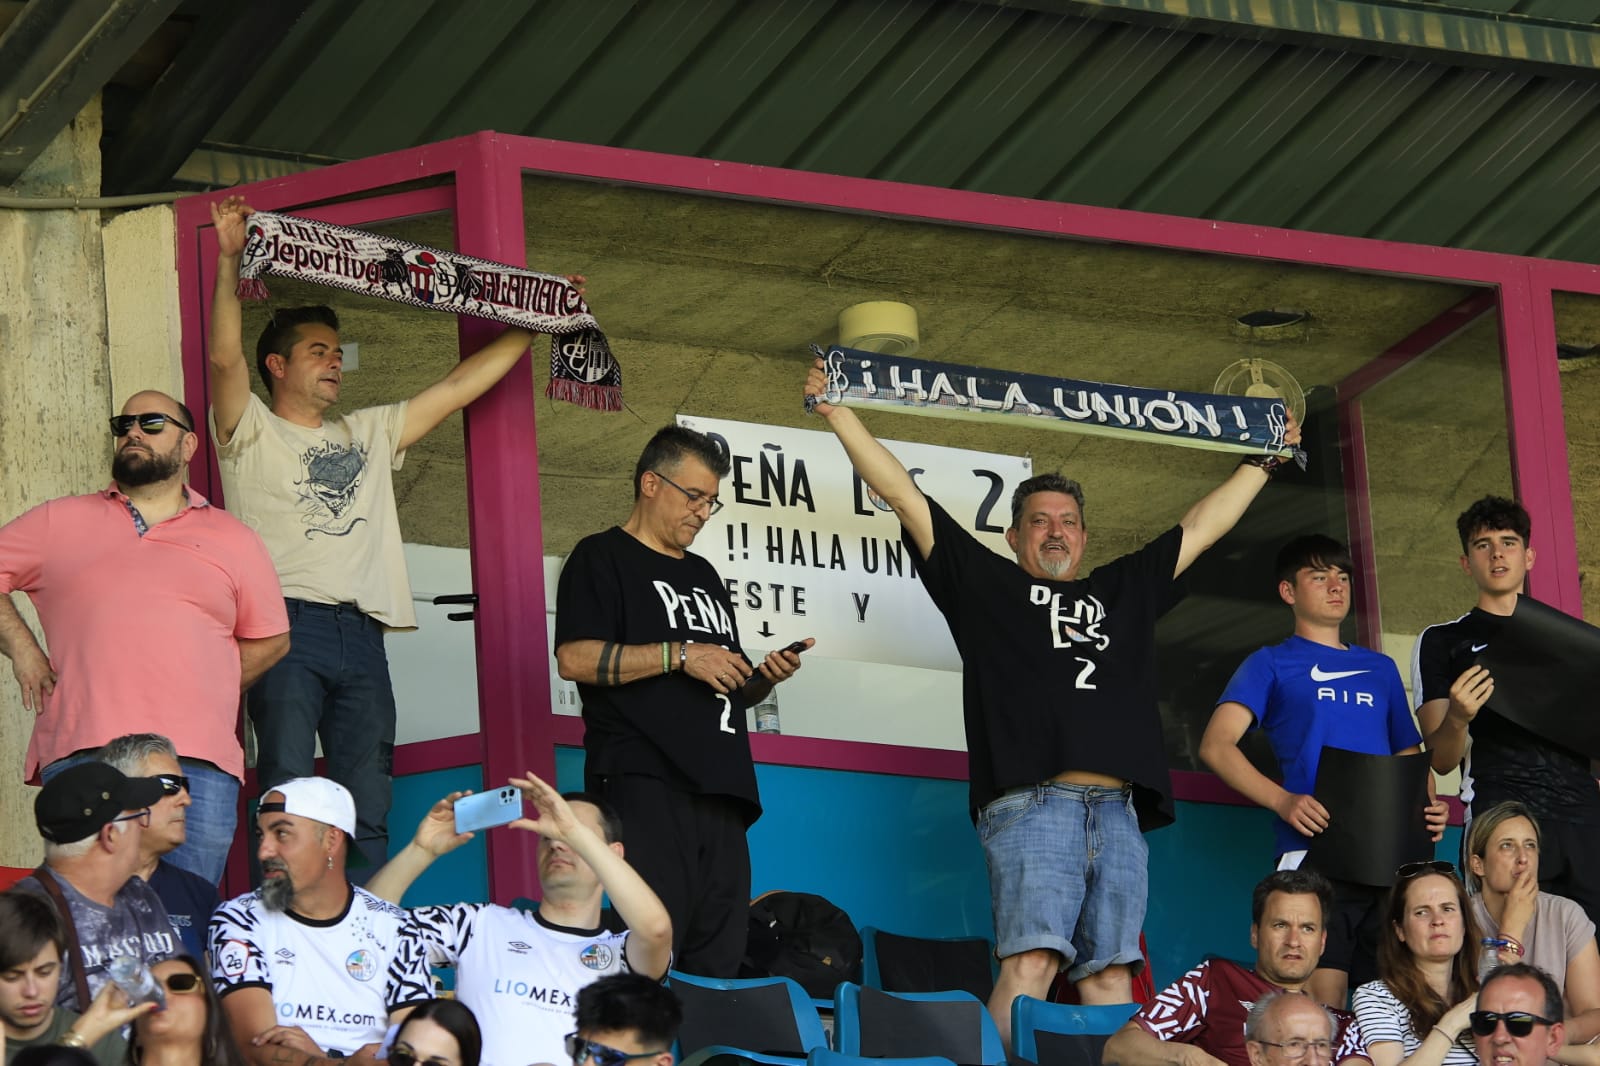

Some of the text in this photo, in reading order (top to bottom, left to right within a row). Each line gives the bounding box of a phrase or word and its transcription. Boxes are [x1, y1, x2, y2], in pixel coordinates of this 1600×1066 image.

[890, 365, 1043, 415] HALA
[1053, 391, 1223, 438] UNIÓN
[766, 525, 846, 571] HALA
[652, 580, 735, 642] PEÑA
[723, 578, 870, 623] ESTE Y
[1074, 656, 1097, 690] 2
[715, 693, 736, 734] 2
[1317, 687, 1375, 708] AIR
[275, 1001, 377, 1026] OMEX.com
